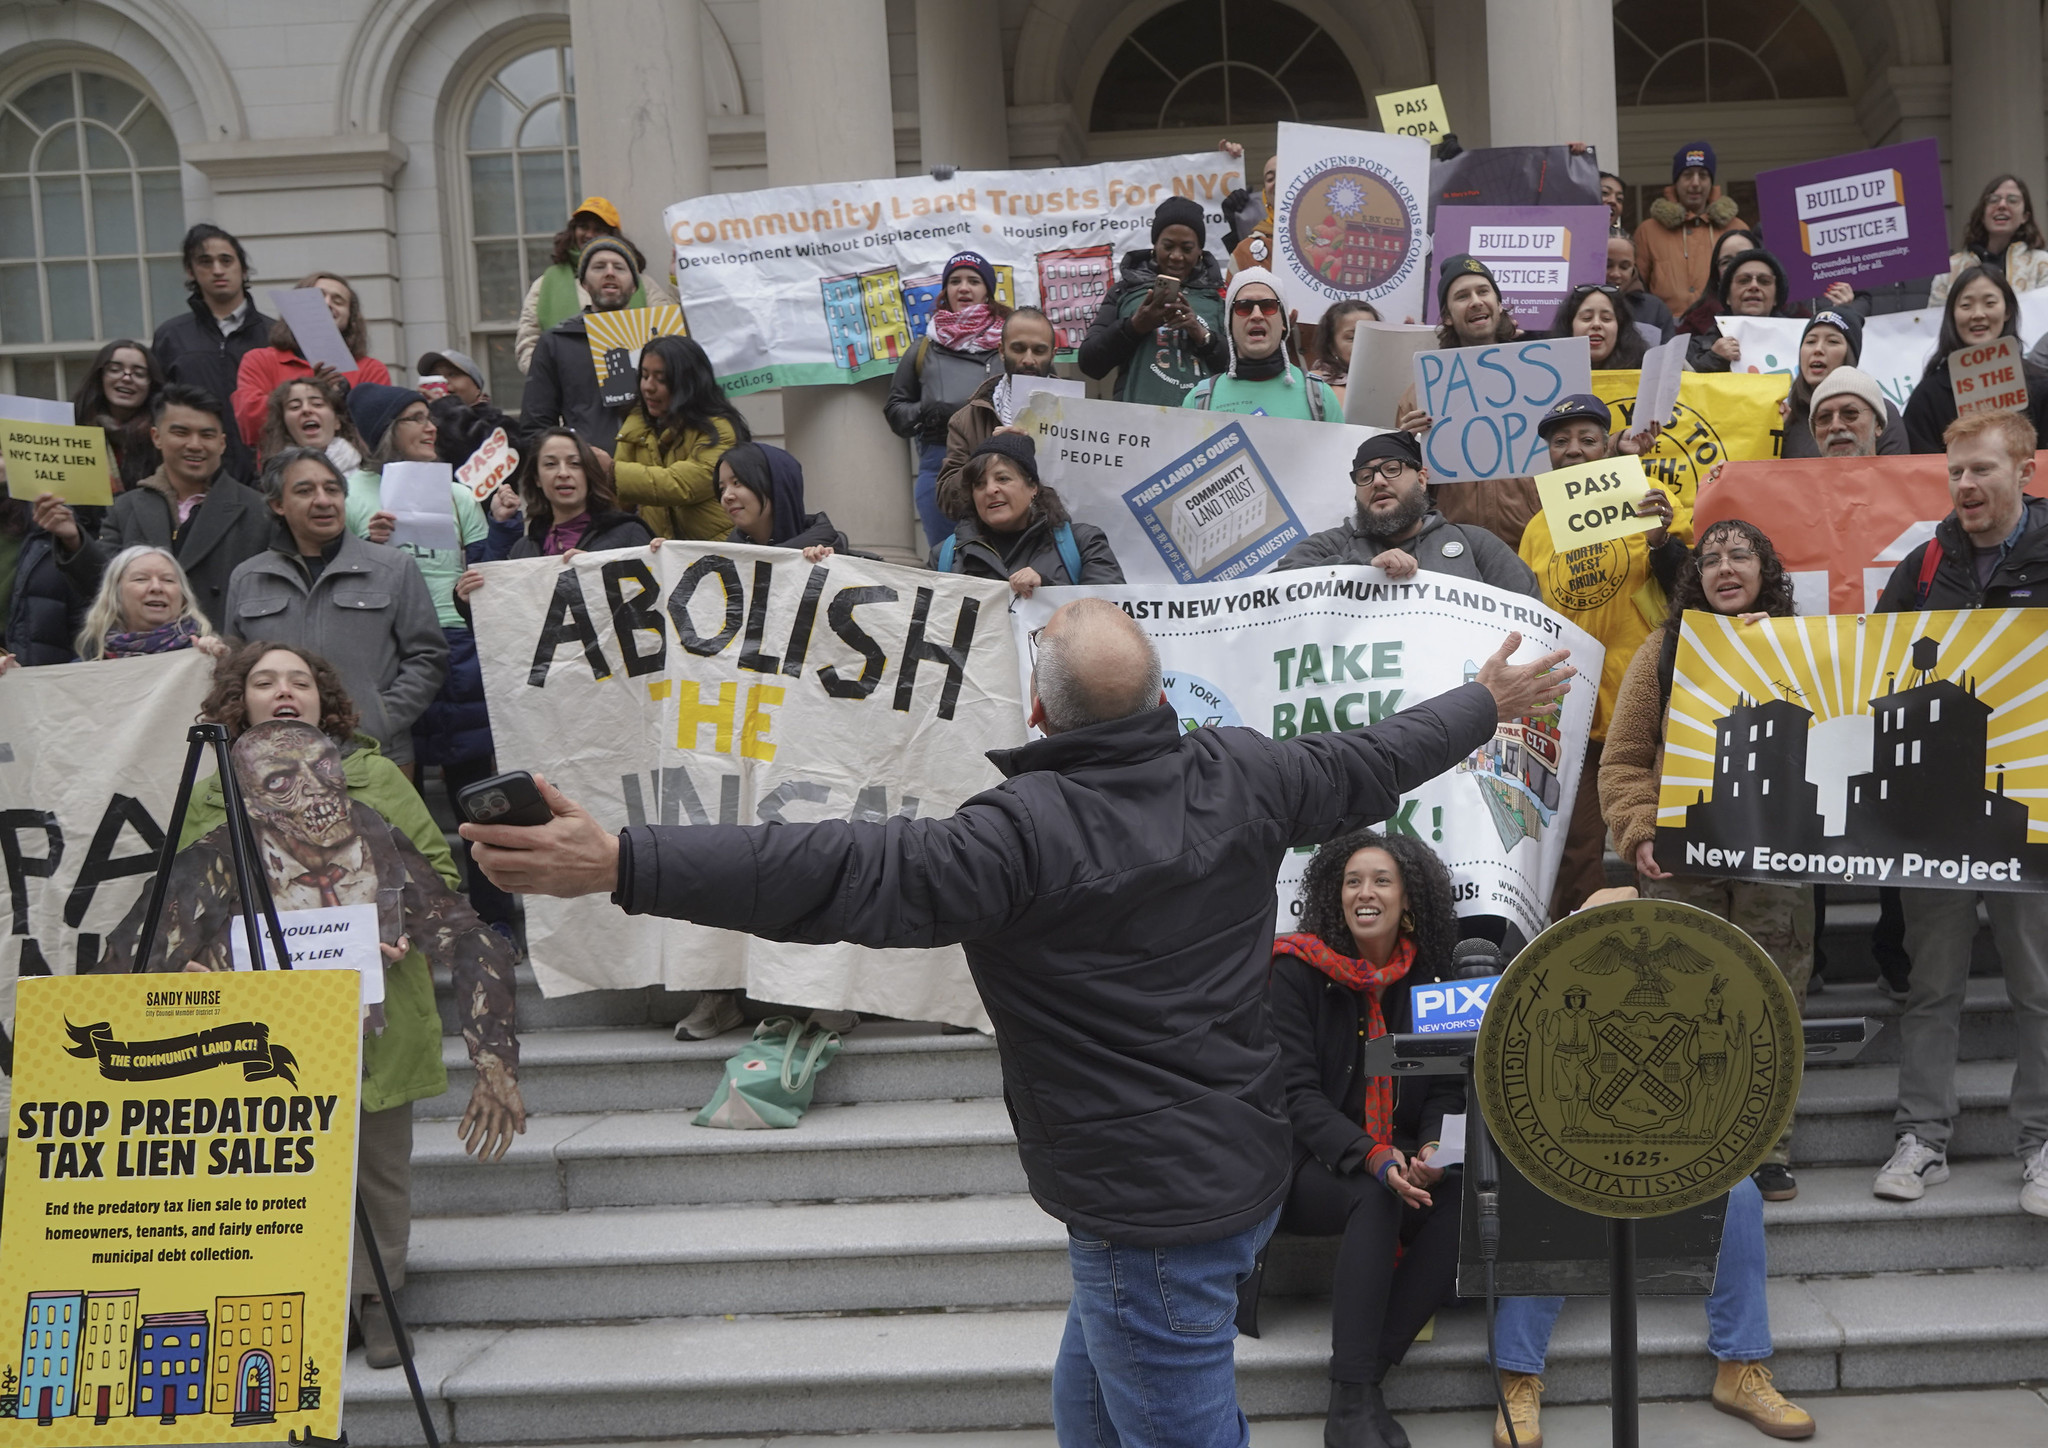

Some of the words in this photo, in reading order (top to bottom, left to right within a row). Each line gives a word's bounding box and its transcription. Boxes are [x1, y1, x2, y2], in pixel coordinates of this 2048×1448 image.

[1394, 98, 1428, 117] PASS
[1280, 175, 1305, 214] MOTT
[1303, 155, 1348, 181] HAVEN
[1358, 156, 1393, 178] PORT
[1390, 175, 1422, 226] MORRIS
[1806, 184, 1859, 210] BUILD
[1861, 179, 1886, 199] UP
[670, 198, 881, 246] Community
[891, 188, 977, 220] Land
[985, 187, 1100, 216] Trusts
[1107, 178, 1162, 208] for
[1171, 171, 1241, 201] NYC
[679, 244, 792, 270] Development
[794, 239, 860, 257] Without
[864, 221, 972, 247] Displacement
[1003, 222, 1069, 239] Housing
[1072, 218, 1096, 234] for
[1100, 215, 1153, 232] People
[1478, 234, 1529, 249] BUILD
[1532, 234, 1555, 249] UP
[1816, 219, 1884, 247] JUSTICE
[1885, 216, 1898, 234] NYC
[1279, 225, 1323, 293] STEWARDS
[1364, 237, 1423, 302] COMMUNITY
[1811, 255, 1851, 271] Grounded
[1852, 255, 1862, 264] in
[1862, 246, 1910, 262] community.
[1813, 265, 1857, 280] Advocating
[1858, 260, 1870, 272] for
[1871, 259, 1884, 269] all.
[1493, 269, 1545, 284] USTICE
[1547, 269, 1559, 284] NYC
[1323, 286, 1361, 302] LAND
[1515, 306, 1526, 314] for
[1960, 343, 2010, 368] COPA
[1420, 343, 1562, 417] PASS
[1956, 377, 1975, 394] IS
[1978, 366, 2015, 388] THE
[9, 432, 60, 447] ABOLISH
[63, 438, 92, 449] THE
[1039, 422, 1110, 444] HOUSING
[1118, 433, 1151, 448] FOR
[1618, 403, 1683, 430] YS
[1684, 421, 1718, 466] TO
[9, 449, 32, 461] NYC
[34, 452, 60, 464] TAX
[63, 455, 96, 466] LIEN
[459, 429, 507, 483] PASS
[1060, 449, 1124, 467] PEOPLE
[1132, 482, 1163, 508] THIS
[1160, 462, 1195, 490] LAND
[1191, 453, 1208, 470] IS
[1205, 432, 1240, 459] OURS
[34, 469, 66, 481] SALE
[474, 454, 517, 498] COPA
[1185, 464, 1246, 511] COMMUNITY
[1564, 471, 1621, 500] PASS
[1191, 500, 1223, 527] LAND
[1218, 477, 1257, 511] TRUST
[1568, 501, 1639, 533] COPA
[1213, 560, 1248, 584] TIERRA
[1244, 552, 1260, 567] ES
[1257, 526, 1299, 560] NUESTRA
[1565, 543, 1609, 564] NORTH-
[1569, 556, 1601, 576] WEST
[1568, 569, 1608, 592] BRONX
[1112, 600, 1163, 620] AST
[1168, 597, 1223, 620] NEW
[1224, 586, 1280, 615] YORK
[1286, 579, 1430, 602] COMMUNITY
[1434, 585, 1497, 613] LAND
[1499, 602, 1562, 640] TRUST
[527, 553, 980, 721] ABOLISH
[1273, 640, 1404, 692] TAKE
[1189, 682, 1221, 709] YORK
[648, 678, 786, 763] THE
[1273, 688, 1404, 740] BACK
[1497, 726, 1521, 738] YORK
[1526, 732, 1548, 754] CLT
[1685, 840, 1745, 869] New
[1752, 846, 1895, 881] Economy
[1902, 853, 2021, 885] Project
[287, 952, 305, 963] AX
[309, 948, 344, 961] LIEN
[145, 1010, 155, 1018] City
[156, 1009, 175, 1017] Council
[175, 1009, 195, 1017] Member
[195, 1008, 214, 1016] District
[214, 1008, 221, 1016] 37
[146, 991, 183, 1007] SANDY
[185, 990, 221, 1006] NURSE
[1416, 983, 1490, 1019] PIX
[1418, 1023, 1441, 1034] NEW
[1441, 1019, 1476, 1031] YORK'S
[110, 1053, 131, 1068] THE
[133, 1045, 198, 1068] COMMUNITY
[201, 1041, 234, 1056] LAND
[234, 1039, 258, 1053] ACT!
[17, 1100, 110, 1139] STOP
[121, 1095, 338, 1137] PREDATORY
[1505, 1037, 1547, 1145] SIGILLVM
[1543, 1147, 1670, 1196] CIVITATIS
[1674, 1142, 1738, 1187] NOVI
[1732, 1041, 1772, 1143] EBORACI
[36, 1141, 105, 1179] TAX
[116, 1139, 196, 1177] LIEN
[207, 1136, 315, 1175] SALES
[1612, 1151, 1661, 1167] 1625
[45, 1201, 69, 1216] End
[73, 1201, 94, 1216] the
[98, 1200, 160, 1216] predatory
[163, 1199, 184, 1213] tax
[187, 1198, 211, 1212] lien
[215, 1197, 242, 1212] sale
[245, 1198, 259, 1210] to
[262, 1197, 307, 1212] protect
[45, 1226, 133, 1241] homeowners,
[136, 1224, 188, 1239] tenants,
[191, 1222, 216, 1237] and
[219, 1221, 252, 1238] fairly
[255, 1221, 304, 1236] enforce
[91, 1249, 154, 1265] municipal
[157, 1248, 187, 1263] debt
[190, 1247, 254, 1262] collection.
